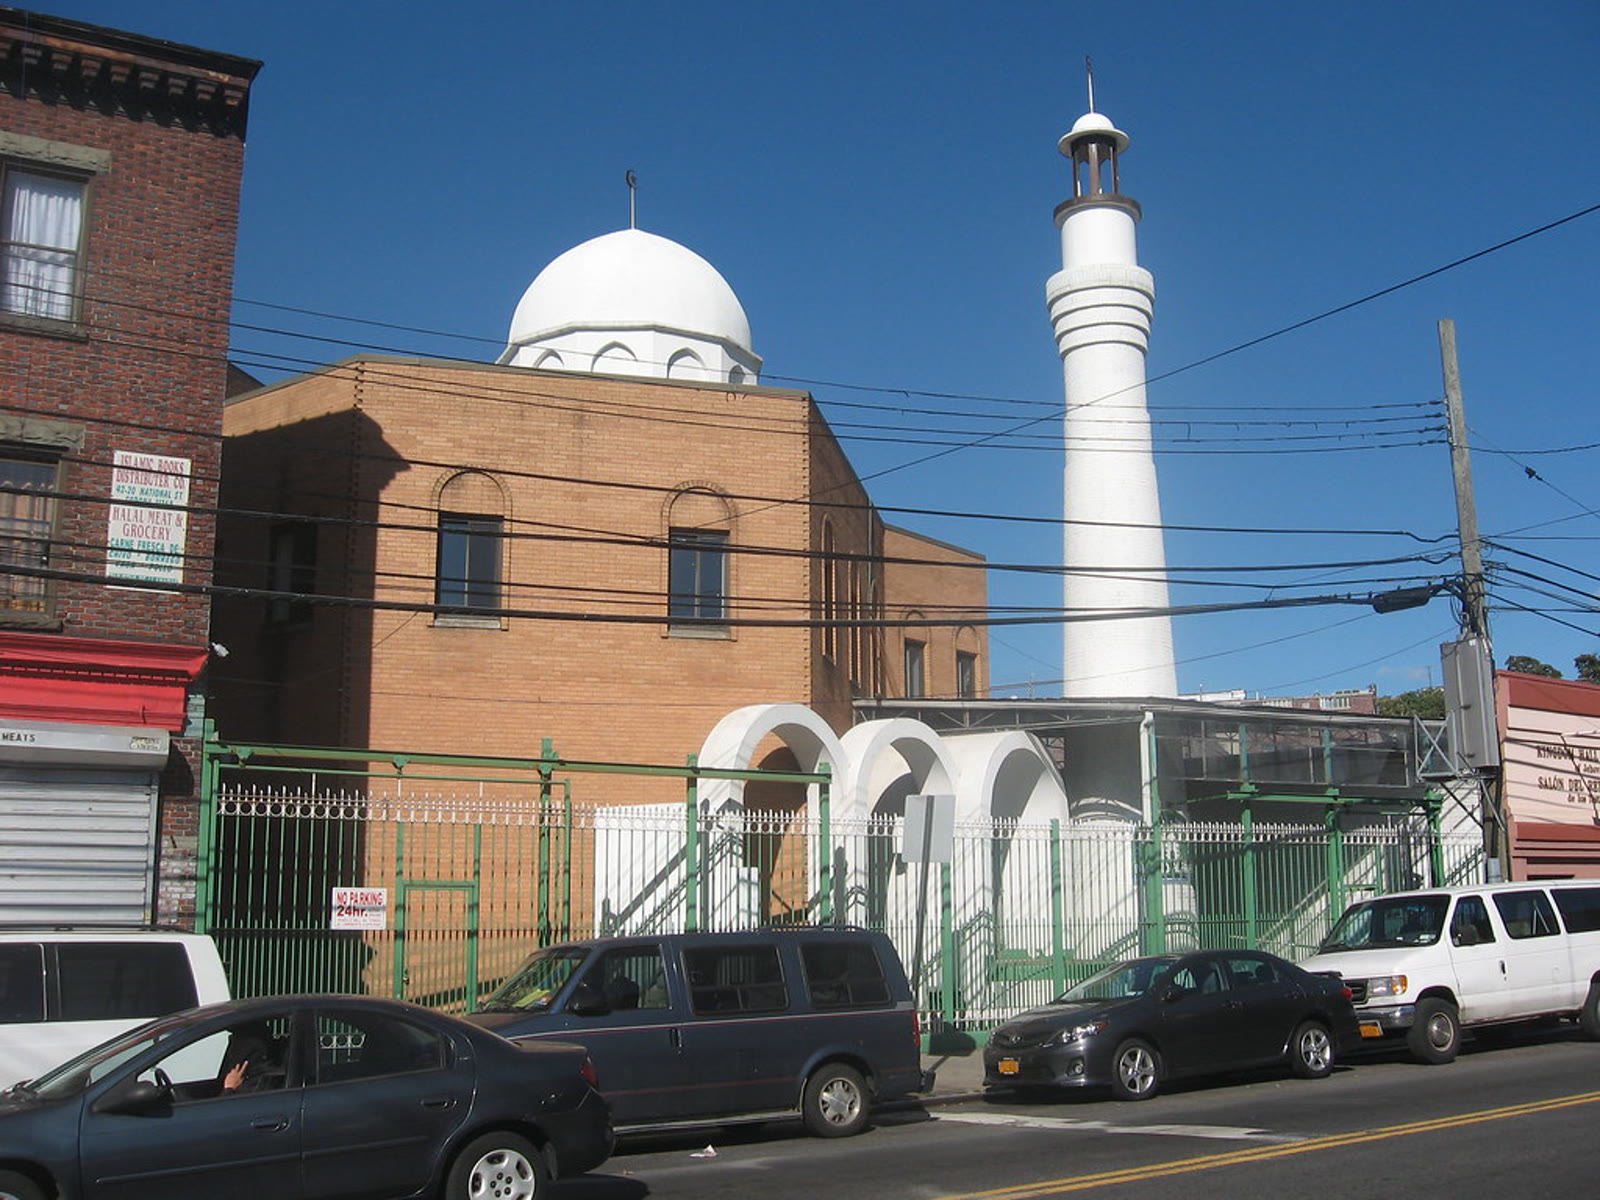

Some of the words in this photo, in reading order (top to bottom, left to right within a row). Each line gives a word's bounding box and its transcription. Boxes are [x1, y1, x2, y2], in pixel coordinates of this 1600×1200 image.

[121, 454, 153, 470] ISLAMIC
[158, 459, 185, 474] BOOKS
[140, 487, 171, 499] NATIONAL
[112, 506, 144, 523] HALAL
[148, 509, 172, 527] MEAT
[175, 514, 184, 527] &
[122, 523, 172, 541] GROCERY
[137, 540, 165, 552] FRESCA
[2, 732, 36, 742] MEATS
[1536, 745, 1574, 760] KINGDOM
[1537, 776, 1564, 791] SALÓN
[1568, 778, 1584, 791] DEL
[337, 891, 348, 905] NO
[350, 891, 384, 905] PARKING
